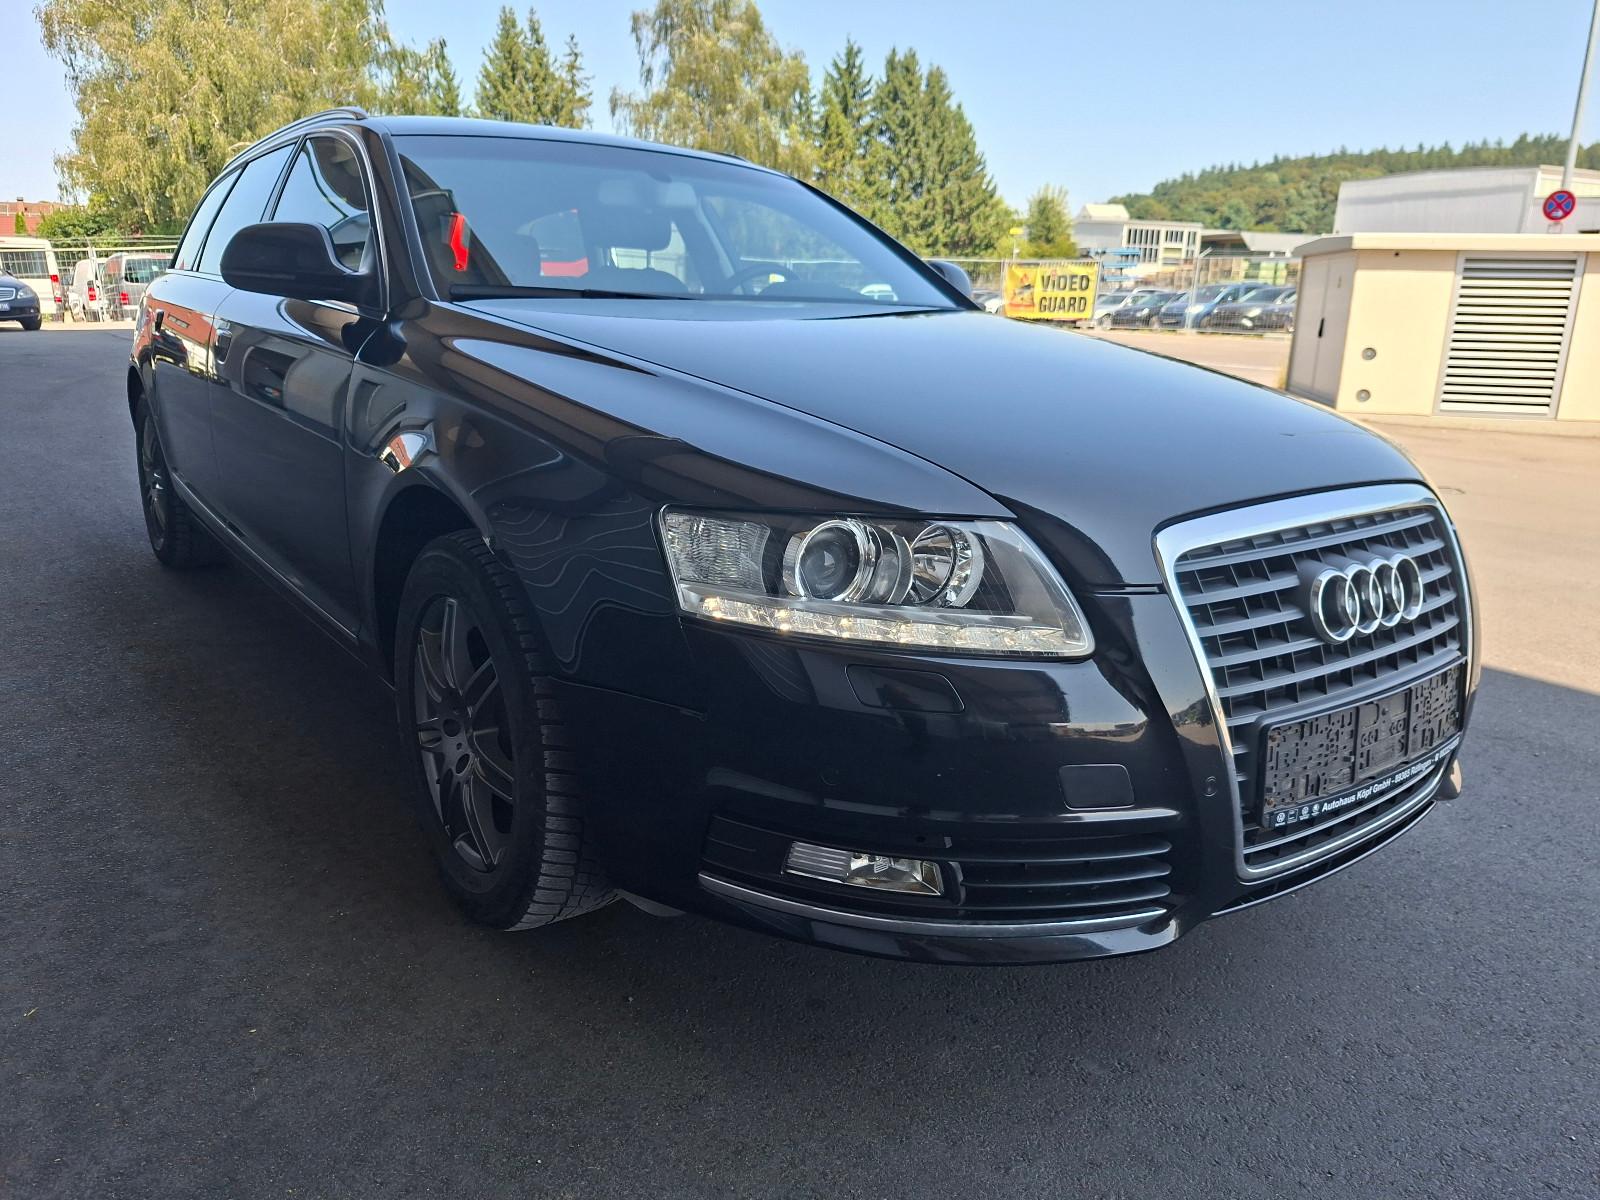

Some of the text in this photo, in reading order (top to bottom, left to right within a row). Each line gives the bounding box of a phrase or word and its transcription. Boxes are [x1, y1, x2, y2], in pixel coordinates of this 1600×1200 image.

[1039, 296, 1087, 313] GUARD
[1322, 794, 1356, 813] Autohaus
[1356, 786, 1373, 800] Köpf
[1372, 777, 1391, 793] GmbH
